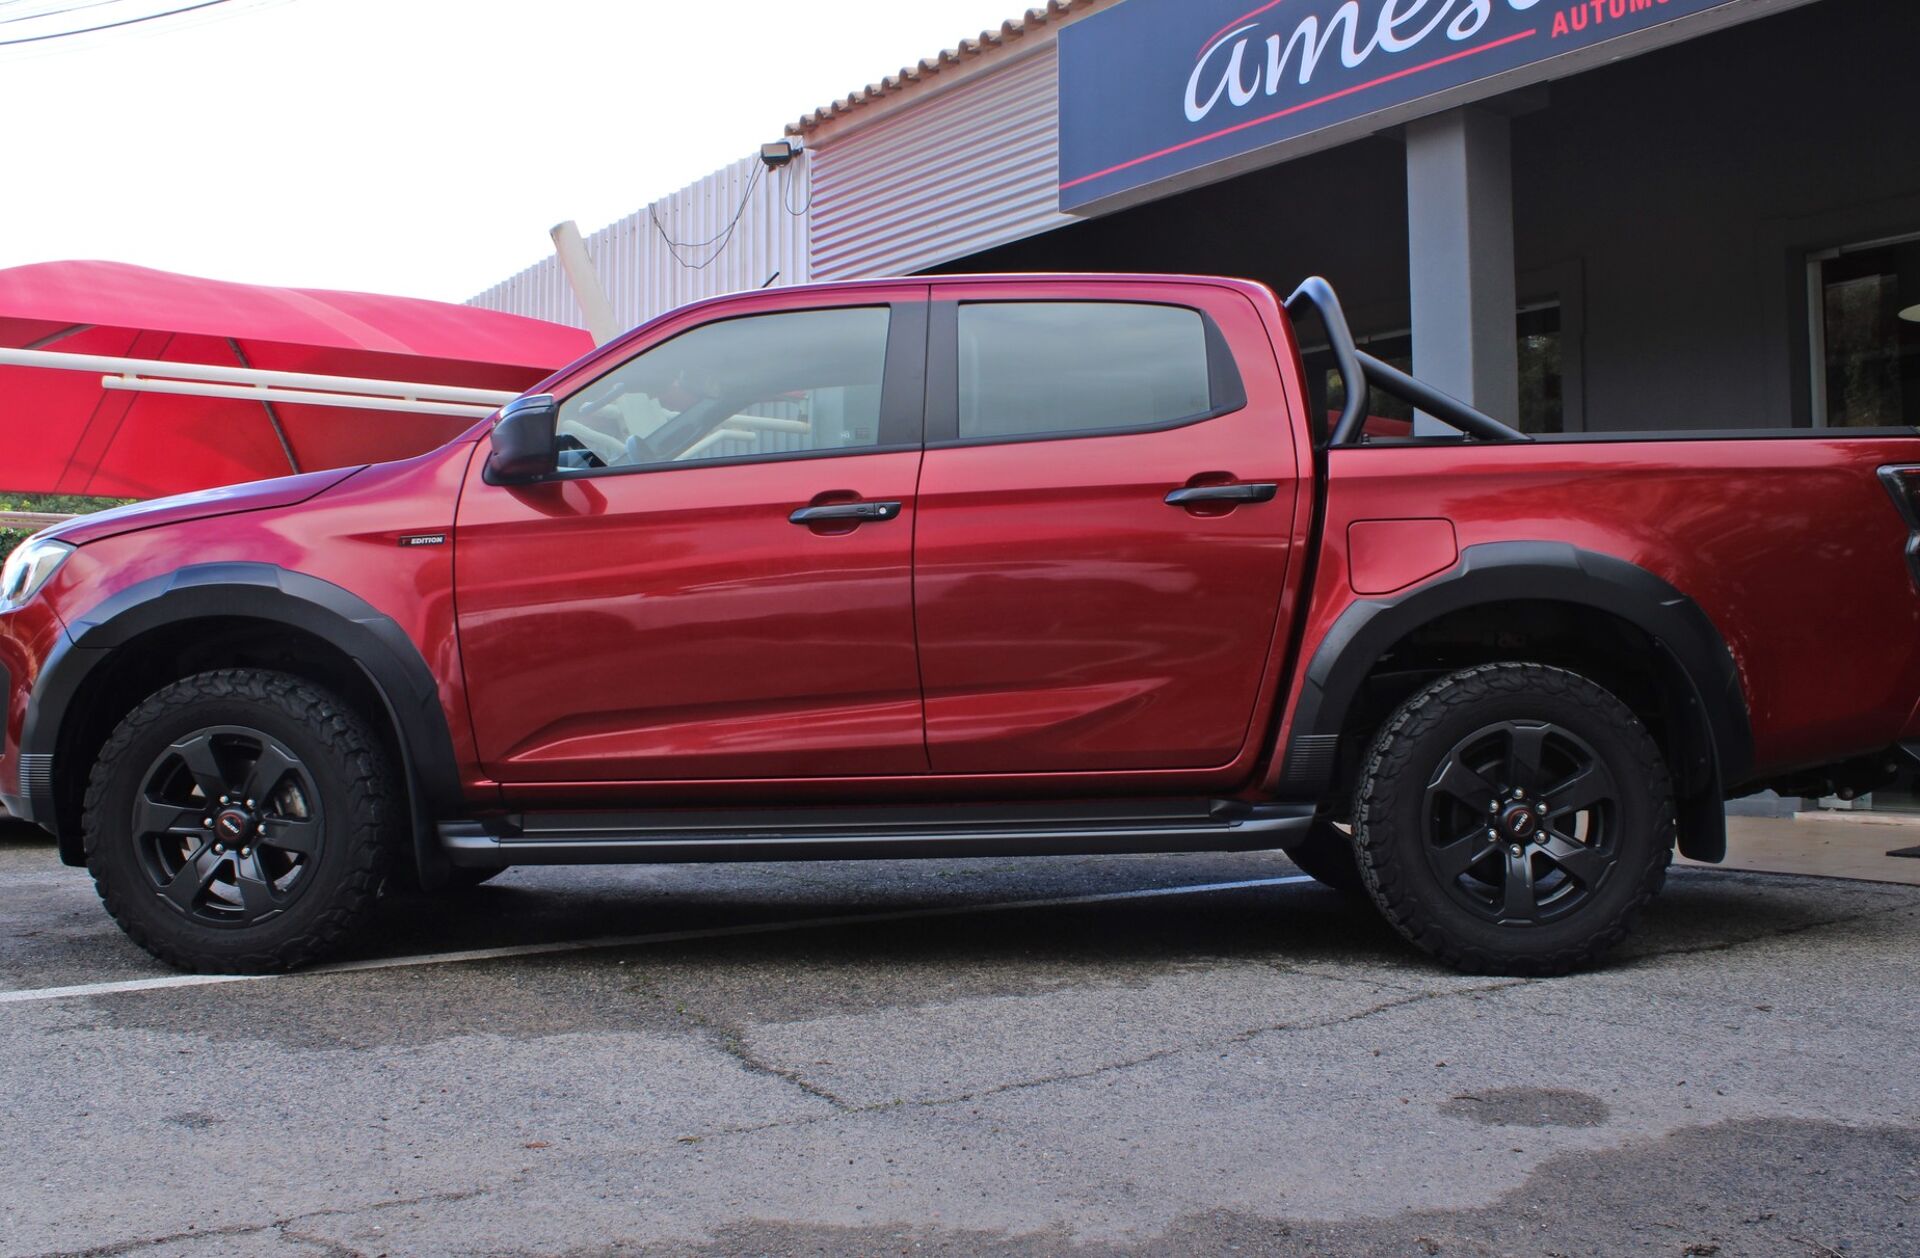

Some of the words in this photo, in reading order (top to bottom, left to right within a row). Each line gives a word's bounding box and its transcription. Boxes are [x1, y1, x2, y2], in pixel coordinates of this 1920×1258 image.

[1551, 0, 1669, 38] AUTO
[1184, 0, 1541, 123] ames
[410, 536, 444, 545] EDITION
